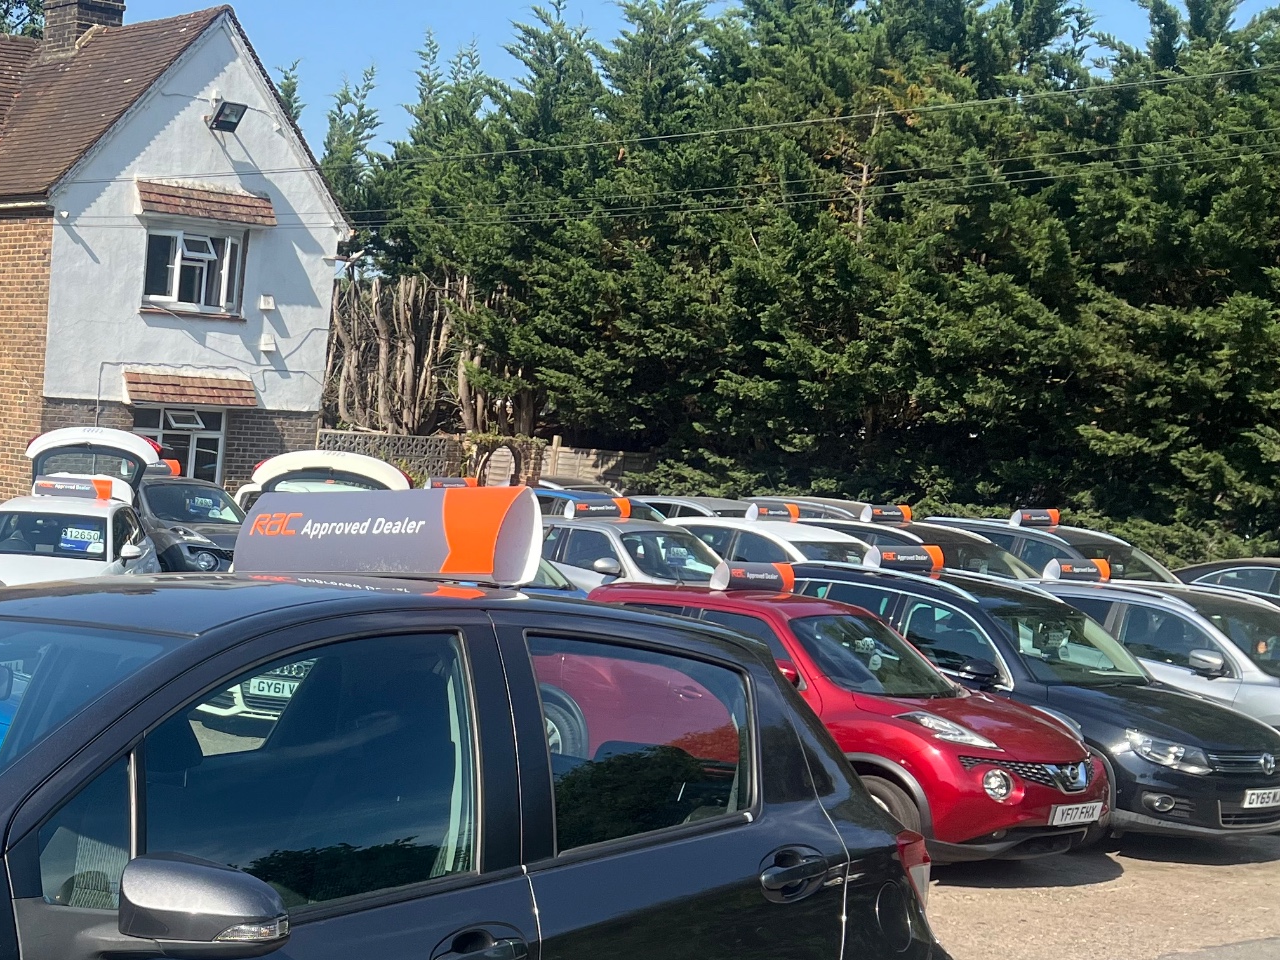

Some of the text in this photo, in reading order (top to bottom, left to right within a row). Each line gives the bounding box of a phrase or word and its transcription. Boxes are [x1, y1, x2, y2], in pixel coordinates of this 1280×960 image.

[249, 512, 426, 539] RAC Approved Dealer
[257, 681, 285, 695] GY61
[1248, 791, 1272, 805] GY65
[1060, 804, 1098, 822] YF17 FHX
